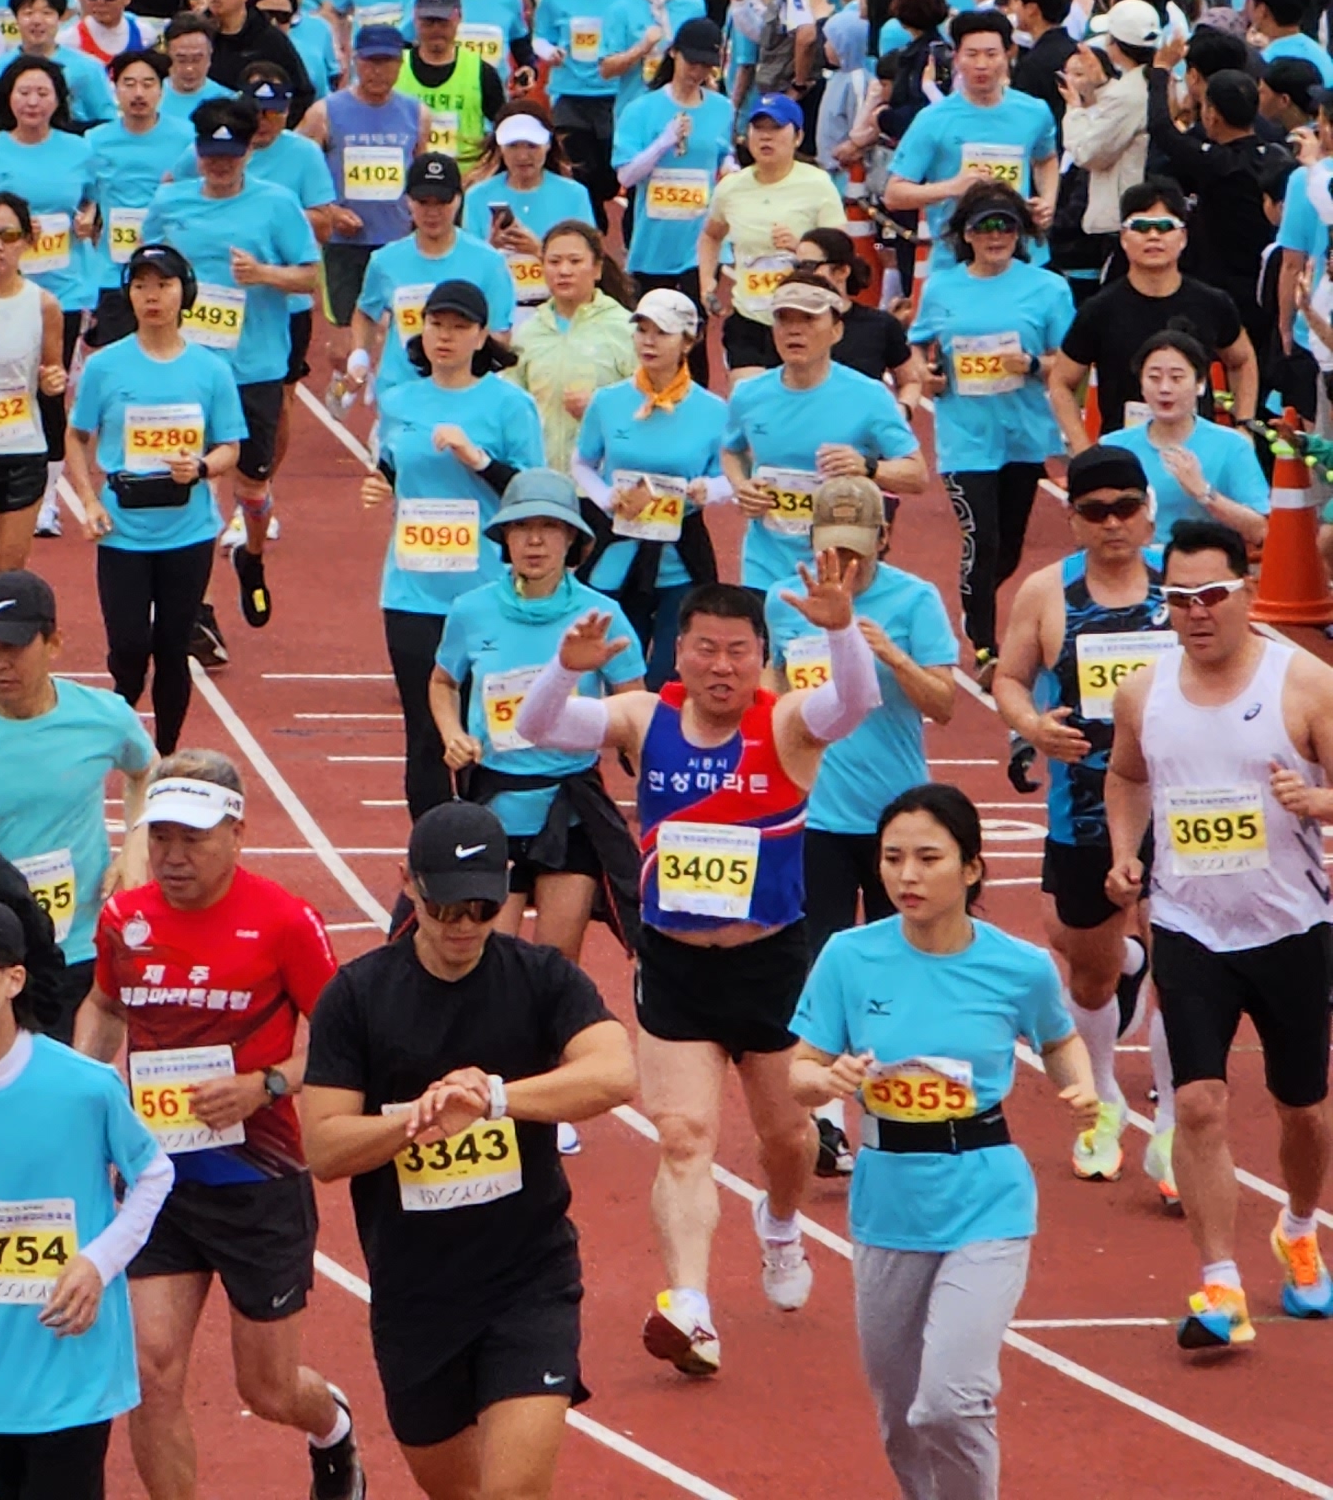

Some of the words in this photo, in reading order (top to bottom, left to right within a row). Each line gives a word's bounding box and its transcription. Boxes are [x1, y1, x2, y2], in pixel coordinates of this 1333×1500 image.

[347, 165, 399, 182] 4102
[112, 228, 137, 243] 33
[509, 264, 543, 281] 36
[960, 356, 1001, 375] 552
[132, 428, 197, 449] 5280
[403, 524, 471, 546] 5090
[793, 665, 829, 689] 53
[1175, 813, 1259, 845] 3695
[664, 854, 748, 887] 3405
[32, 882, 71, 913] 65
[872, 1078, 968, 1110] 5355
[402, 1127, 510, 1174] 3343
